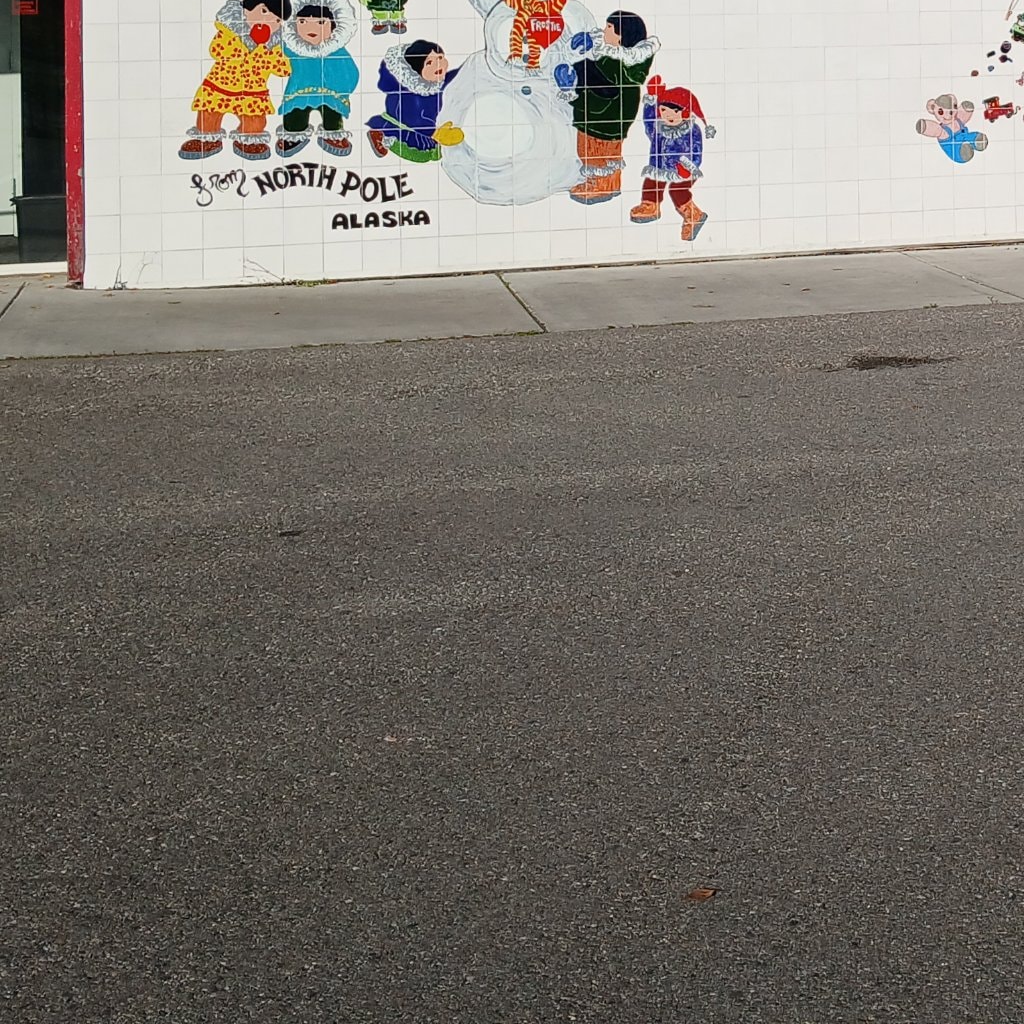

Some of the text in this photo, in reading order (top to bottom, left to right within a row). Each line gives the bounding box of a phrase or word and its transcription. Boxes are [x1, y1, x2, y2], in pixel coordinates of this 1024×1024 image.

[253, 162, 337, 197] NORTH
[337, 170, 414, 203] POLE
[332, 209, 431, 230] ALASKA
